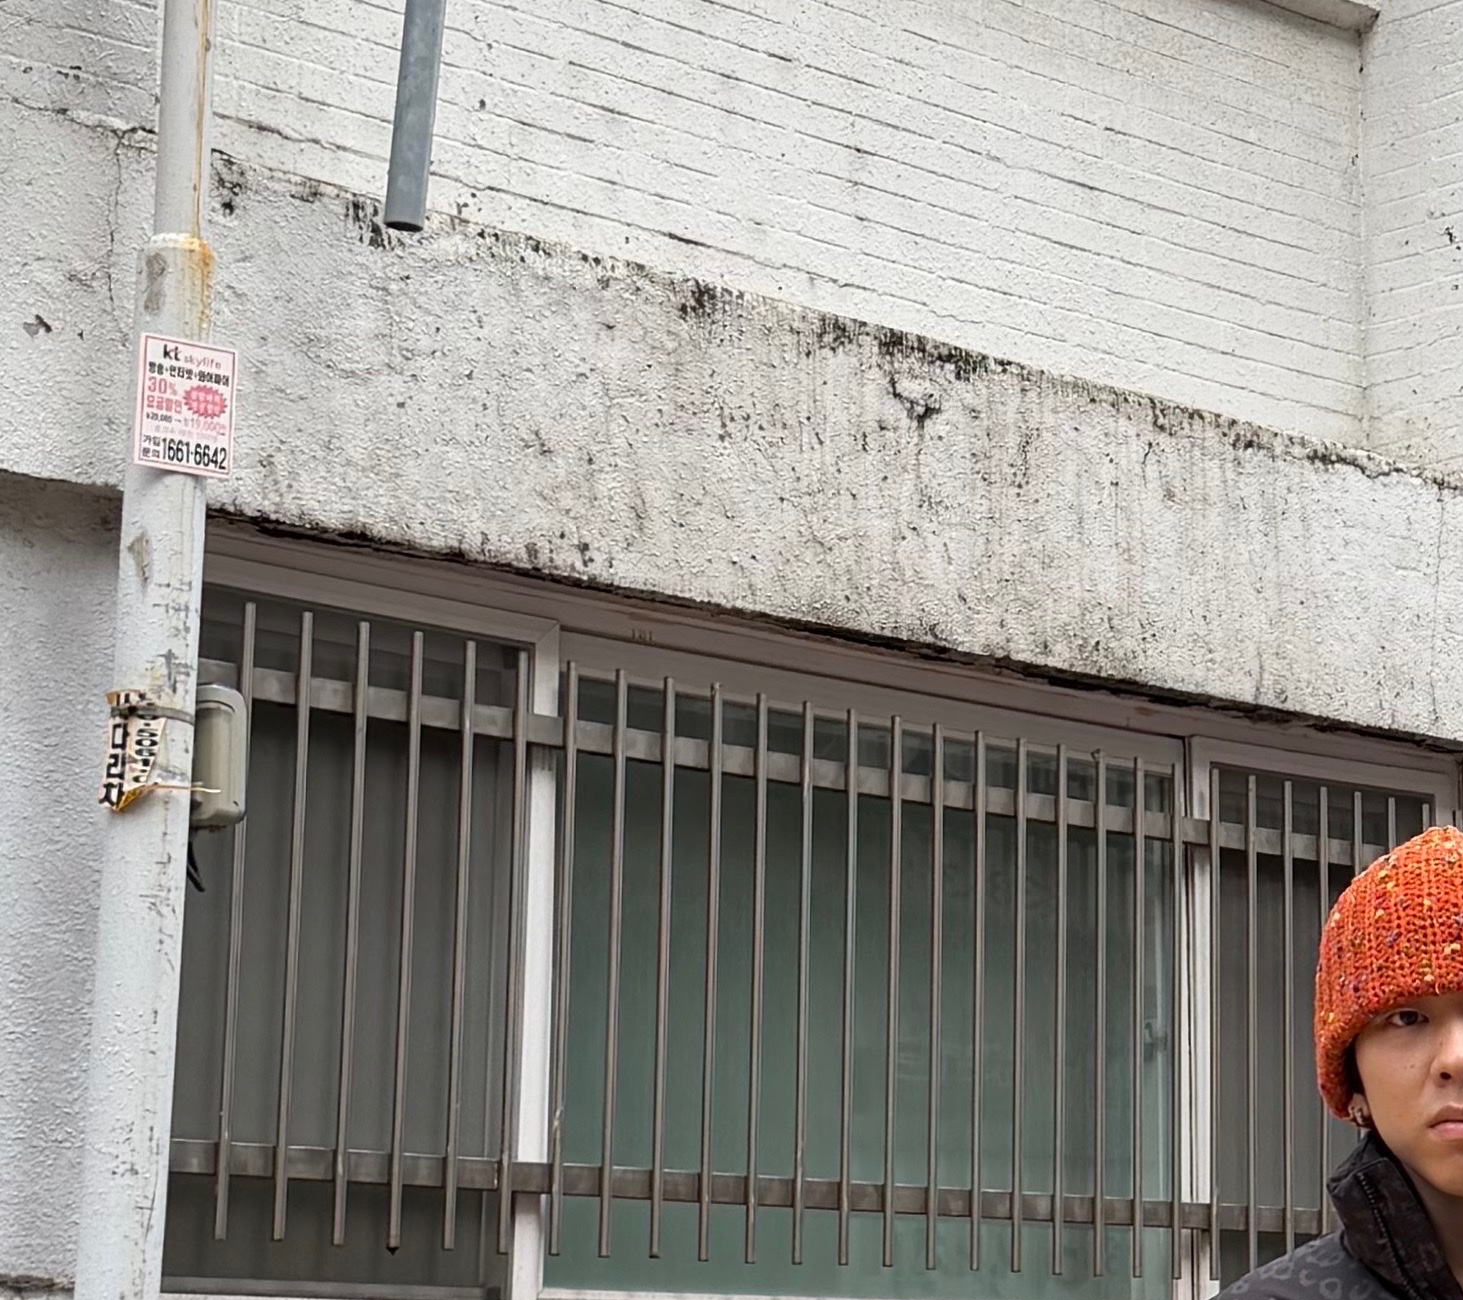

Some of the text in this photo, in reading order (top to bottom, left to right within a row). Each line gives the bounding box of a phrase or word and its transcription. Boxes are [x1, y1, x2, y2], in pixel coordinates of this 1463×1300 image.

[163, 344, 222, 369] kt skylife
[148, 376, 178, 396] 30%
